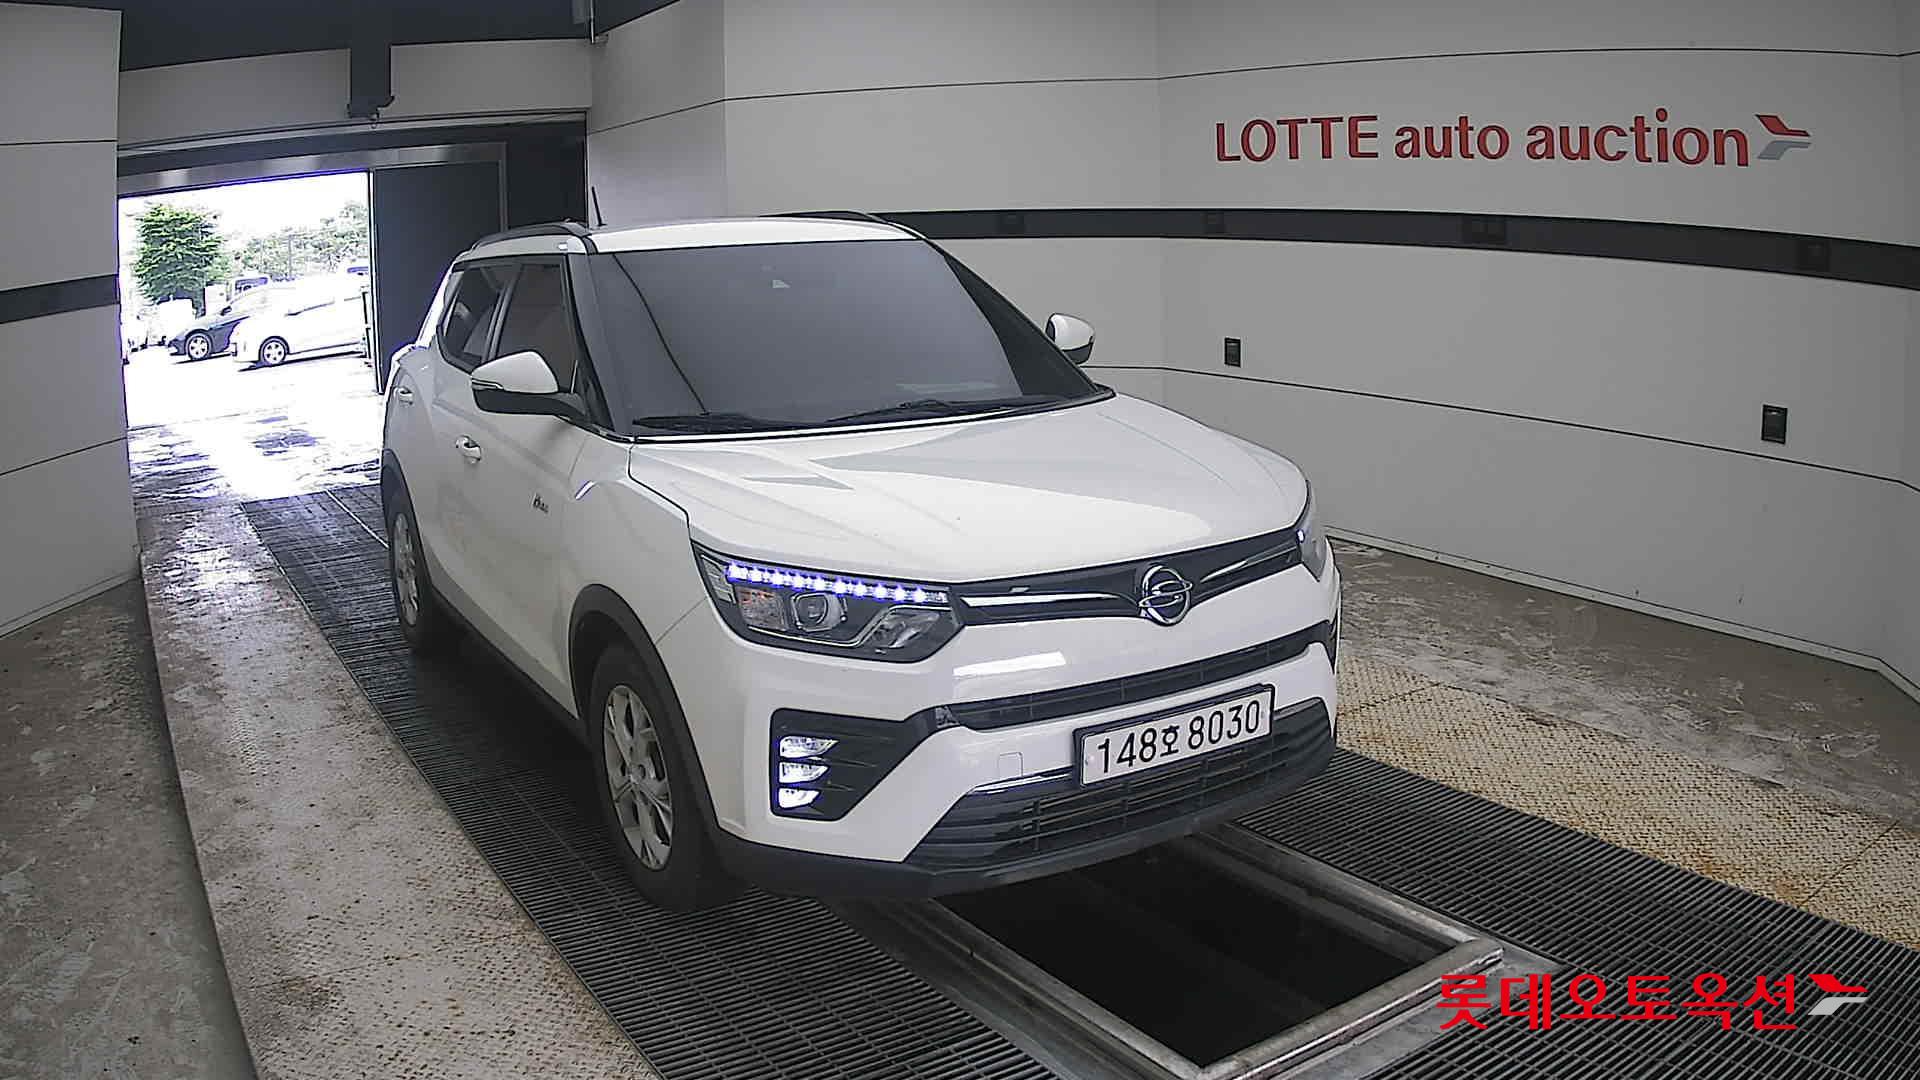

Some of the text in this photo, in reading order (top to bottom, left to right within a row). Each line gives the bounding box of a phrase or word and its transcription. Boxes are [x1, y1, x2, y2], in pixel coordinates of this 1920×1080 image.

[1215, 107, 1750, 167] LOTTE auto auction
